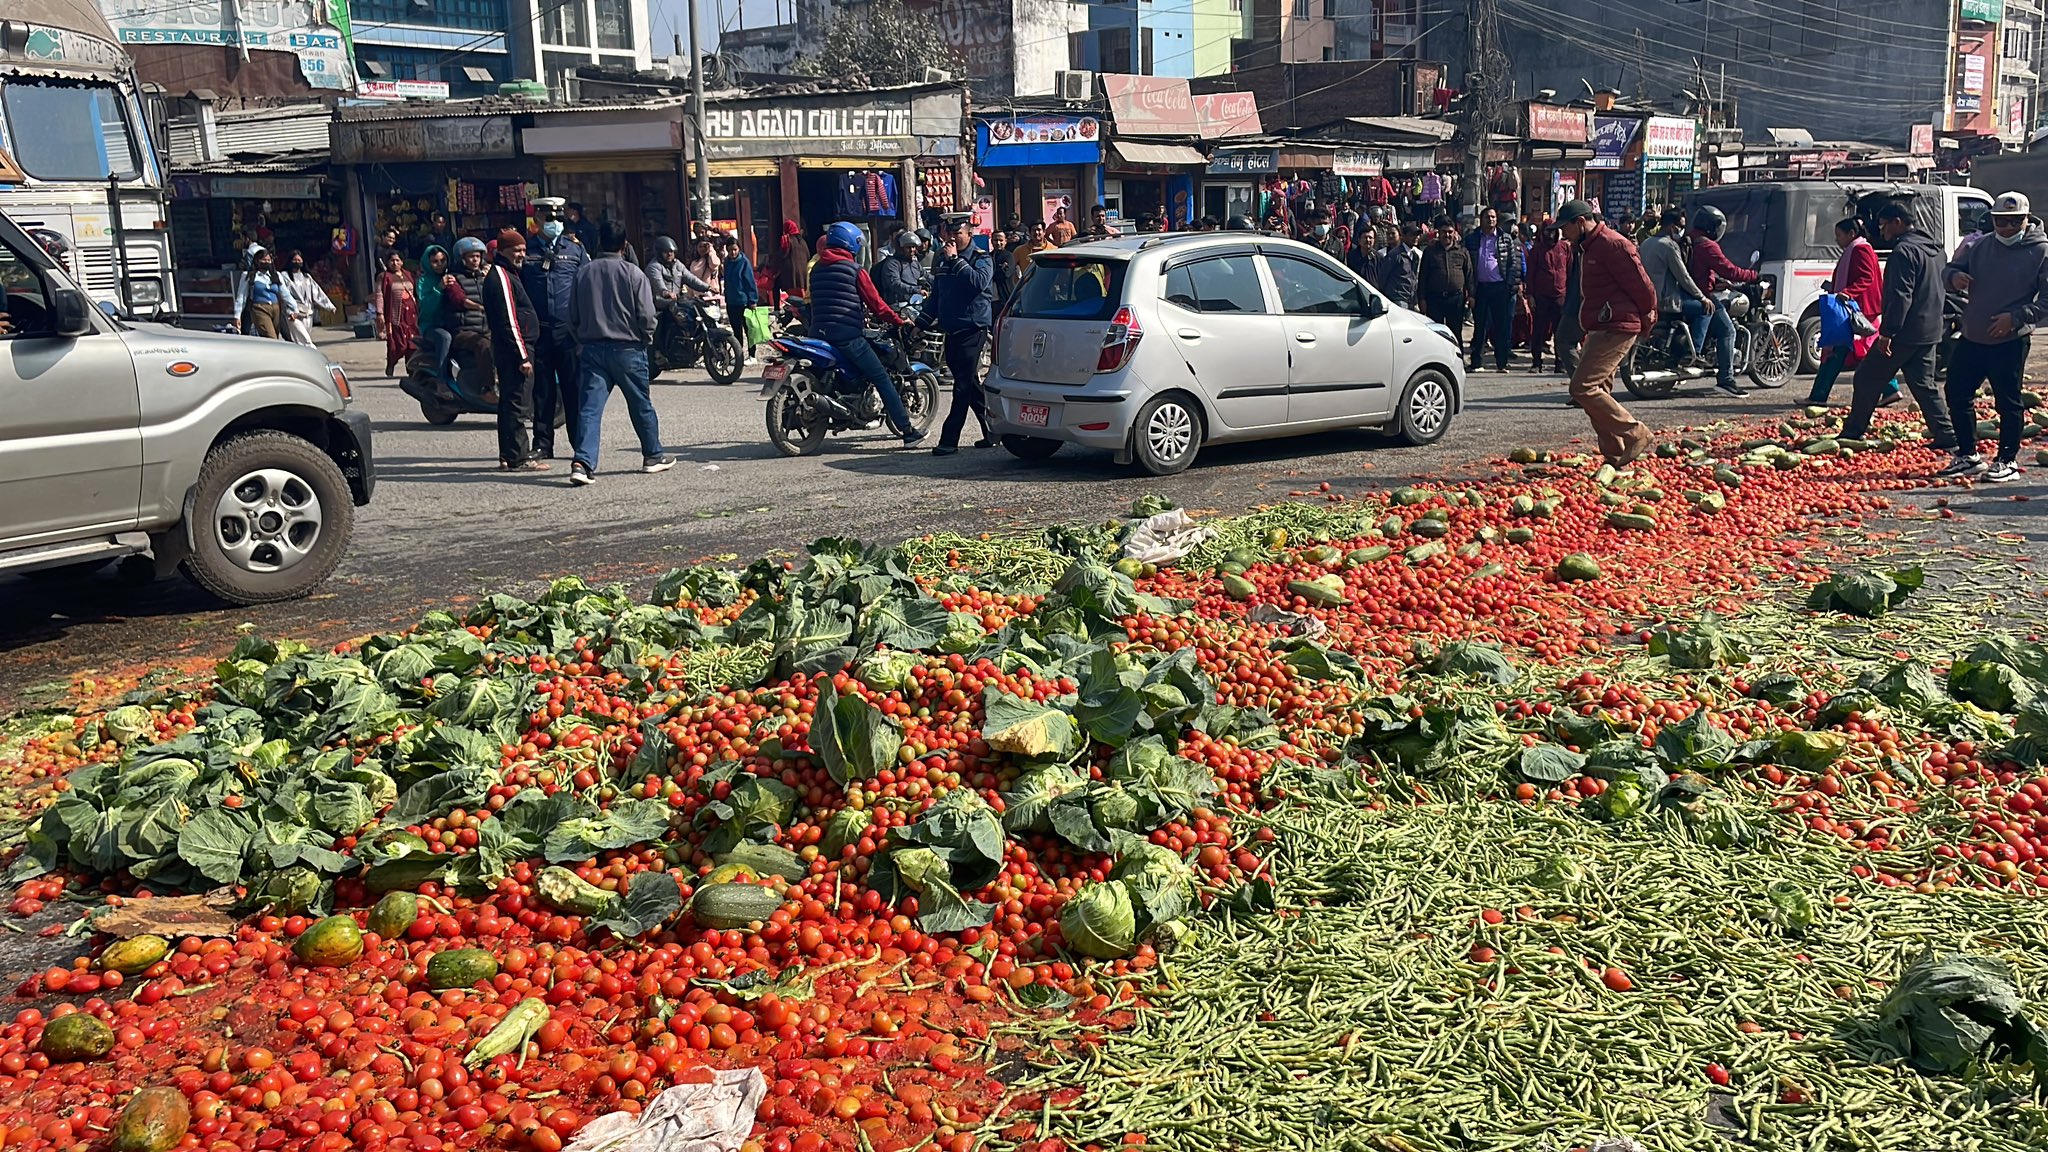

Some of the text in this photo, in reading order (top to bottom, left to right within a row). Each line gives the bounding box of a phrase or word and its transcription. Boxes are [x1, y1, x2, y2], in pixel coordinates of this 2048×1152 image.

[125, 30, 262, 44] RESTAURAT
[295, 34, 337, 48] BAR
[706, 108, 910, 137] RY AGAIN COLLECTION
[1248, 151, 1270, 170] होटल
